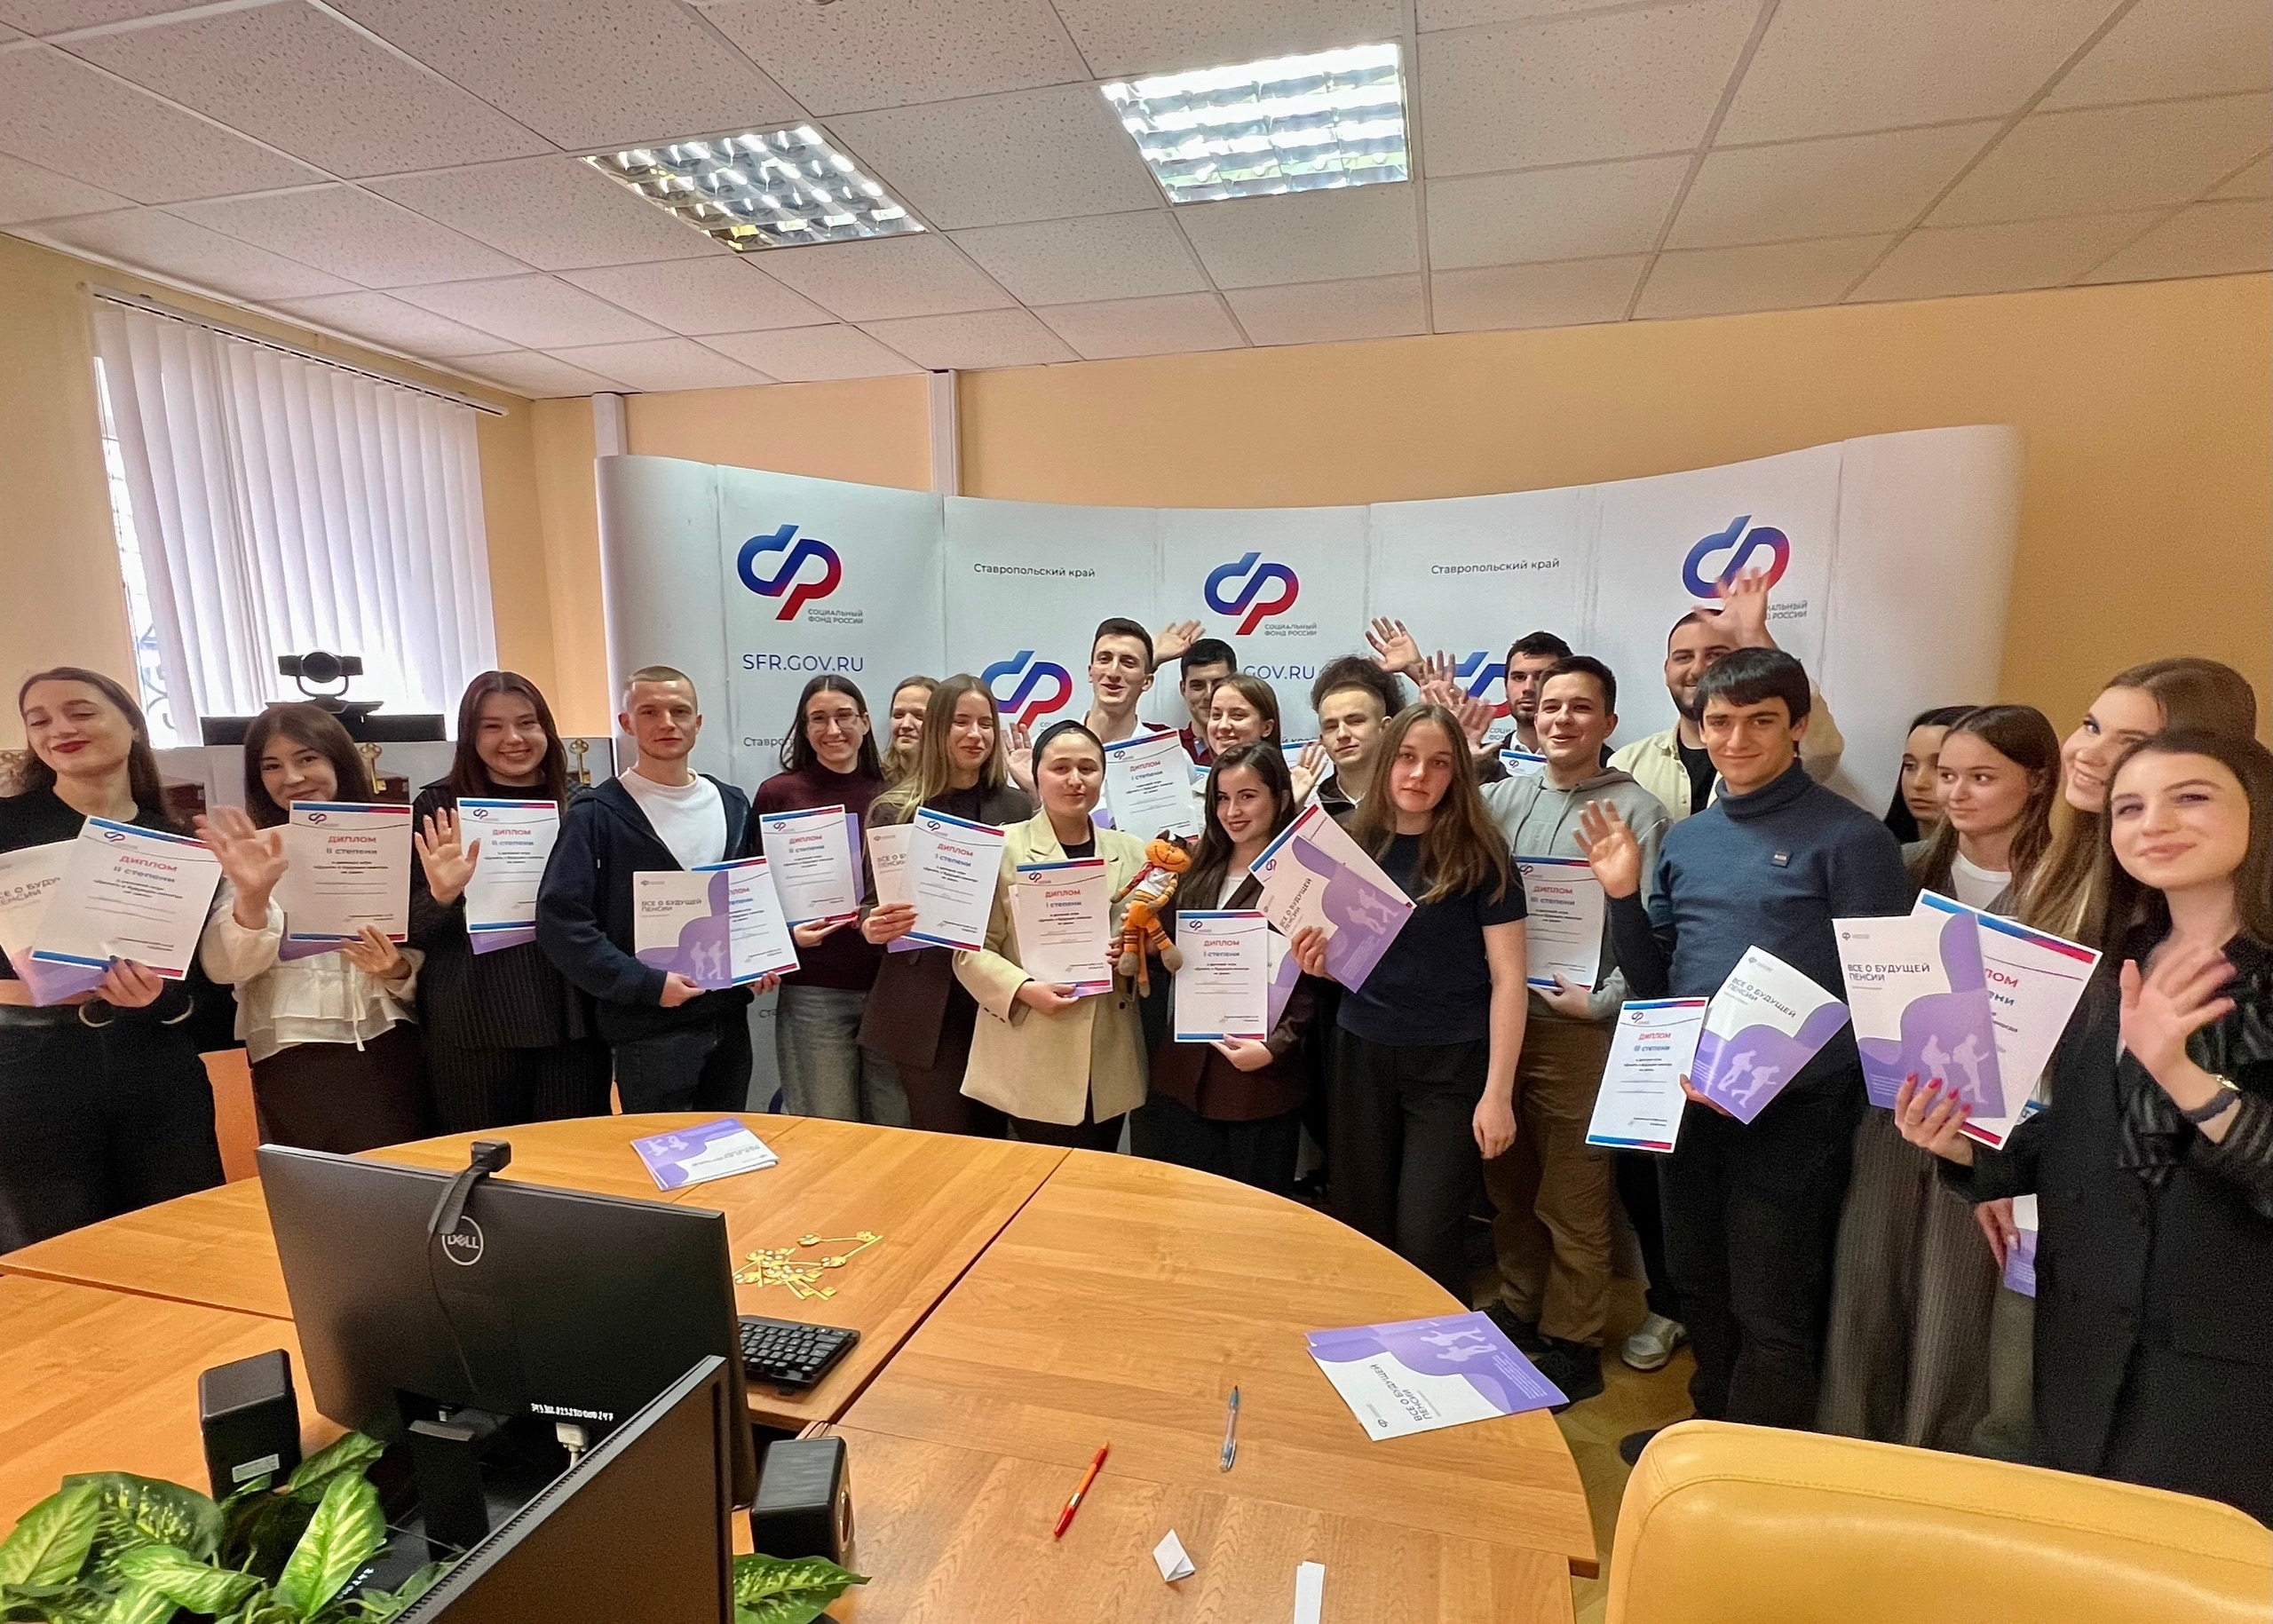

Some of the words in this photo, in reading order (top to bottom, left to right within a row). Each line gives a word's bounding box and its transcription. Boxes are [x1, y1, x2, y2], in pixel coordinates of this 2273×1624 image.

[974, 563, 1065, 576] Ставропольский
[1068, 568, 1096, 578] край
[1431, 560, 1527, 574] Ставропольский
[1531, 558, 1560, 570] край
[1768, 600, 1808, 611] АЛЬНЫЙ
[1772, 610, 1807, 620] РОССИИ
[742, 654, 864, 672] SFR.GOV.RU
[1243, 665, 1315, 680] GOV.RU
[1129, 760, 1160, 772] ДИПЛОМ
[788, 835, 823, 844] ДИПЛОМ
[937, 843, 973, 857] ДИПЛОМ
[119, 855, 178, 872] ДИПЛОМ
[1045, 889, 1081, 899] ДИПЛОМ
[1290, 877, 1313, 910] БУДУЩЕЙ
[1532, 885, 1572, 894] ДИПЛОМ
[1874, 963, 1930, 973] БУДУЩЕЙ
[1984, 968, 2018, 988] ЛОМ
[1727, 983, 1758, 1001] ПЕНСИИ
[1731, 977, 1746, 987] ВСЕ
[1754, 988, 1796, 1018] БУДУЩЕЙ
[1638, 1032, 1672, 1041] ДИПЛОМ
[447, 1234, 479, 1249] DELL
[1371, 1363, 1404, 1398] БУДУЩЕЙ
[1401, 1388, 1432, 1420] ПЕНСИИ
[1406, 1406, 1422, 1422] ВСЕ
